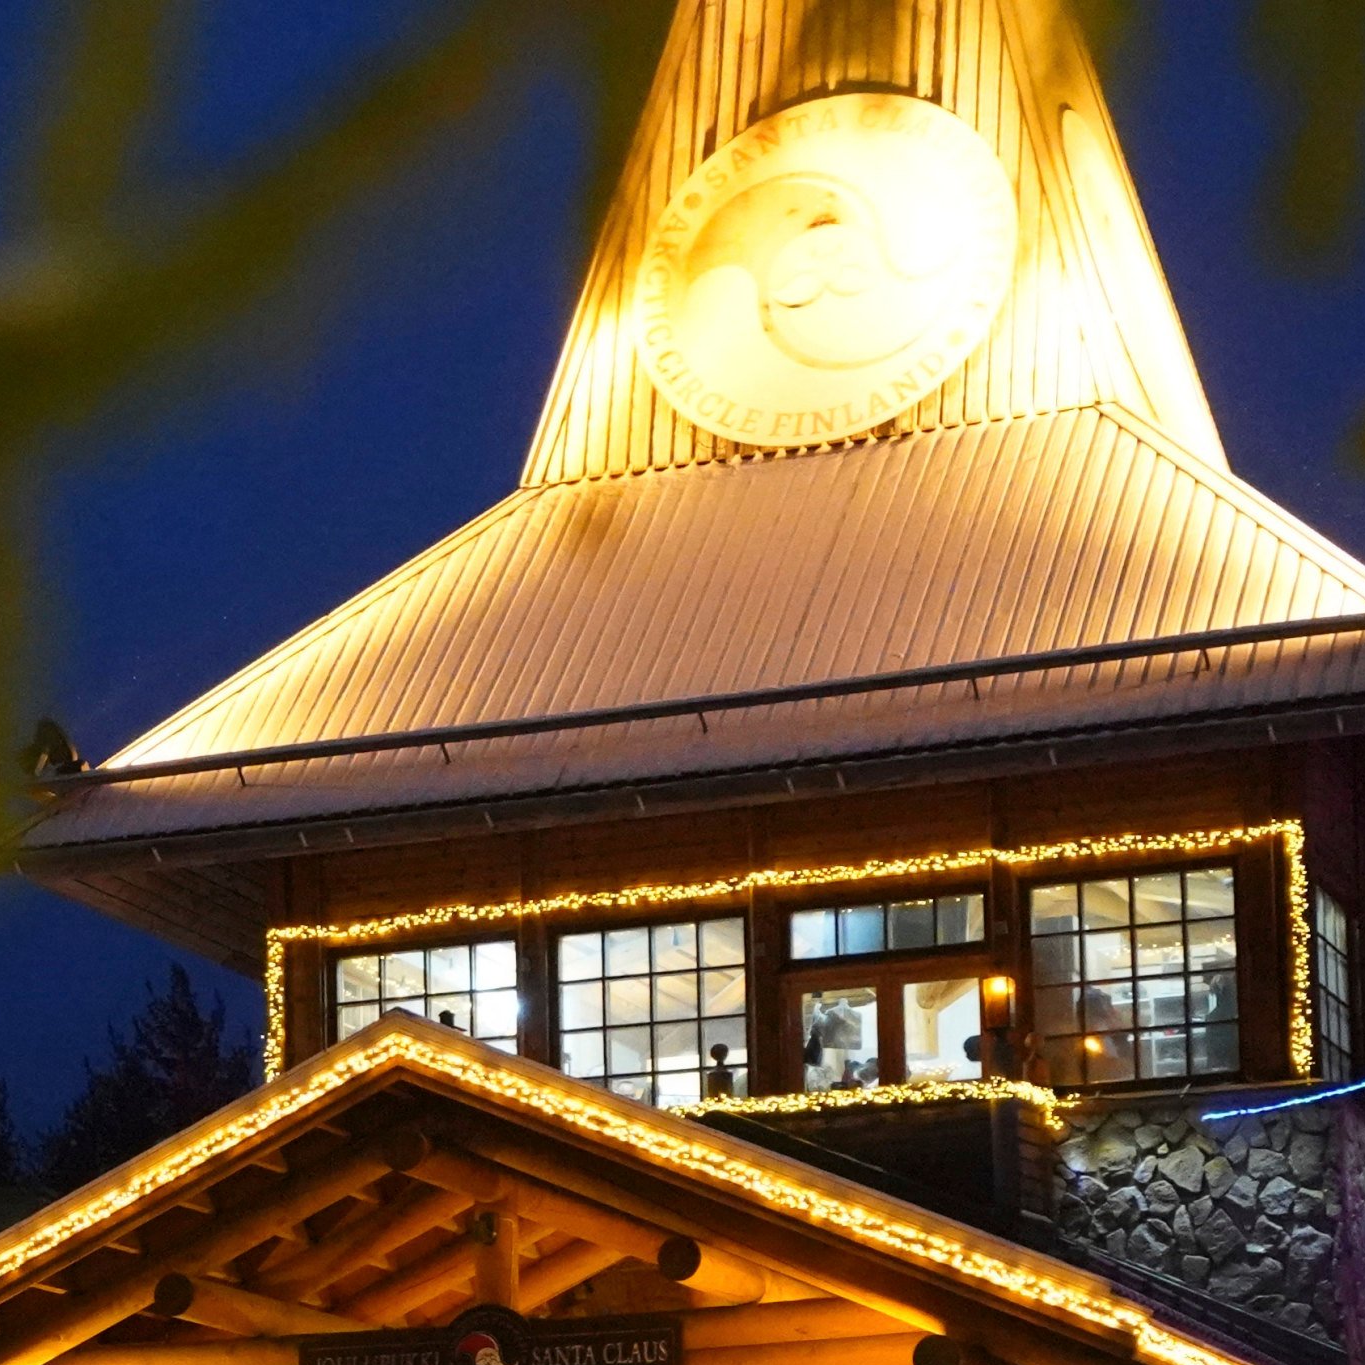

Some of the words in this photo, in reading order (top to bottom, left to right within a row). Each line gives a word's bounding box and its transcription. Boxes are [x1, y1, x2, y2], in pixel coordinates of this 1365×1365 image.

[704, 105, 841, 190] SANTA
[655, 347, 765, 435] CIRCLE
[768, 350, 945, 438] FINLAND
[602, 1338, 669, 1365] CLAUS
